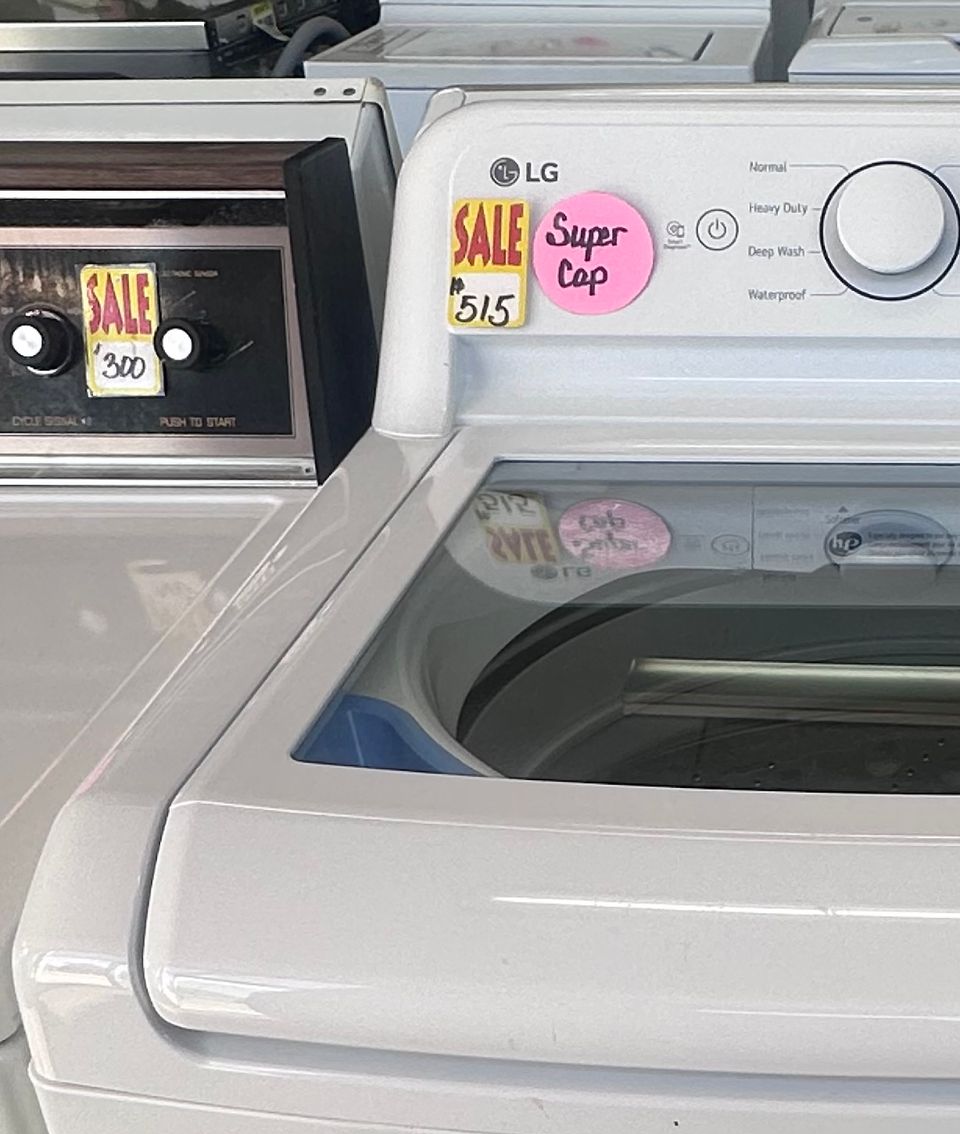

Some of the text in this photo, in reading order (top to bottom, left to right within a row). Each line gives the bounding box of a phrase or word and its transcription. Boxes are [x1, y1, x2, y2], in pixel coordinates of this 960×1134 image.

[525, 162, 558, 183] LG
[749, 162, 787, 173] Normal
[749, 202, 808, 216] Heavy Duty
[453, 201, 525, 267] SALE
[545, 211, 628, 262] Super
[748, 246, 805, 258] Deep Wash
[557, 258, 608, 296] Cap
[748, 289, 807, 301] Waterproof
[87, 273, 152, 336] SALE
[159, 416, 236, 428] PUSH TO START
